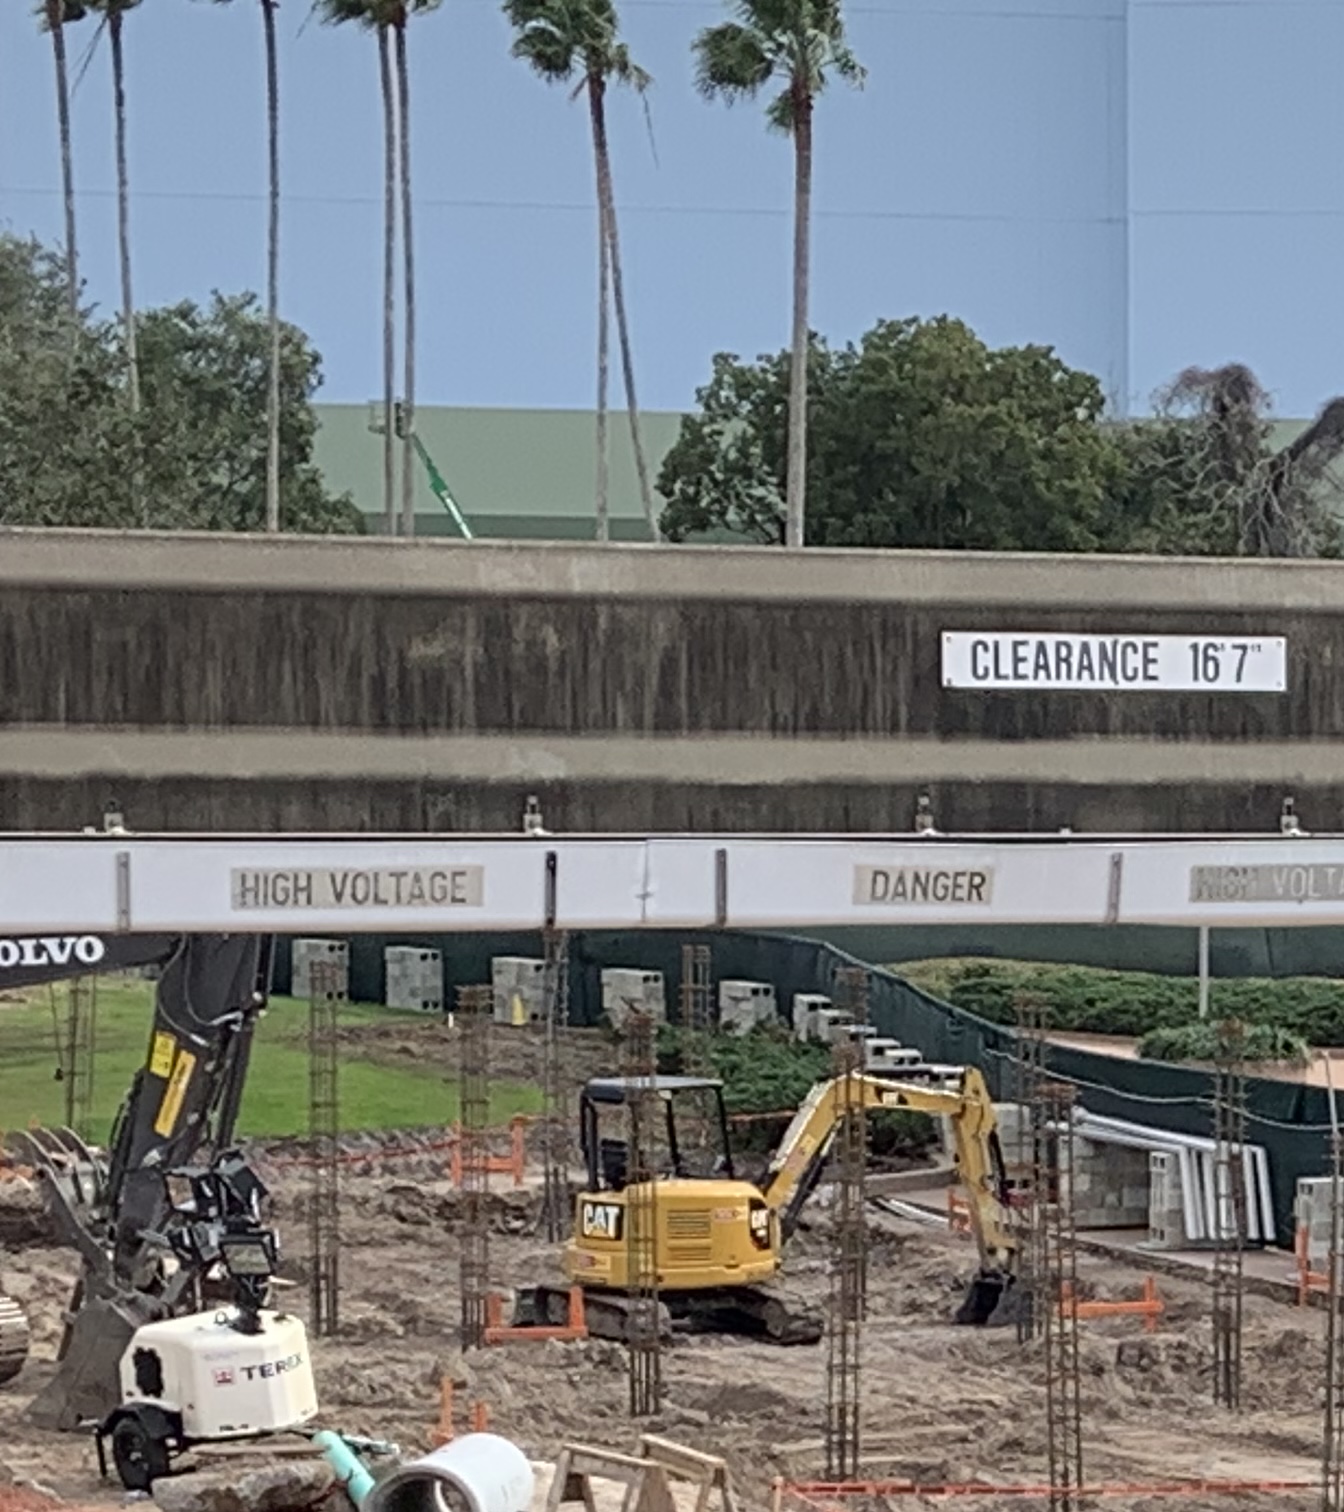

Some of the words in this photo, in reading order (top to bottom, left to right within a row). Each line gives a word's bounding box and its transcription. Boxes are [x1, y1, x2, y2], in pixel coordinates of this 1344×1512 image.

[971, 640, 1159, 684] CLEARANCE
[240, 872, 312, 906] HIGH
[330, 871, 467, 905] VOLTAGE
[870, 870, 987, 901] DANGER
[583, 1204, 621, 1239] CAT
[240, 1352, 303, 1380] TEREX
